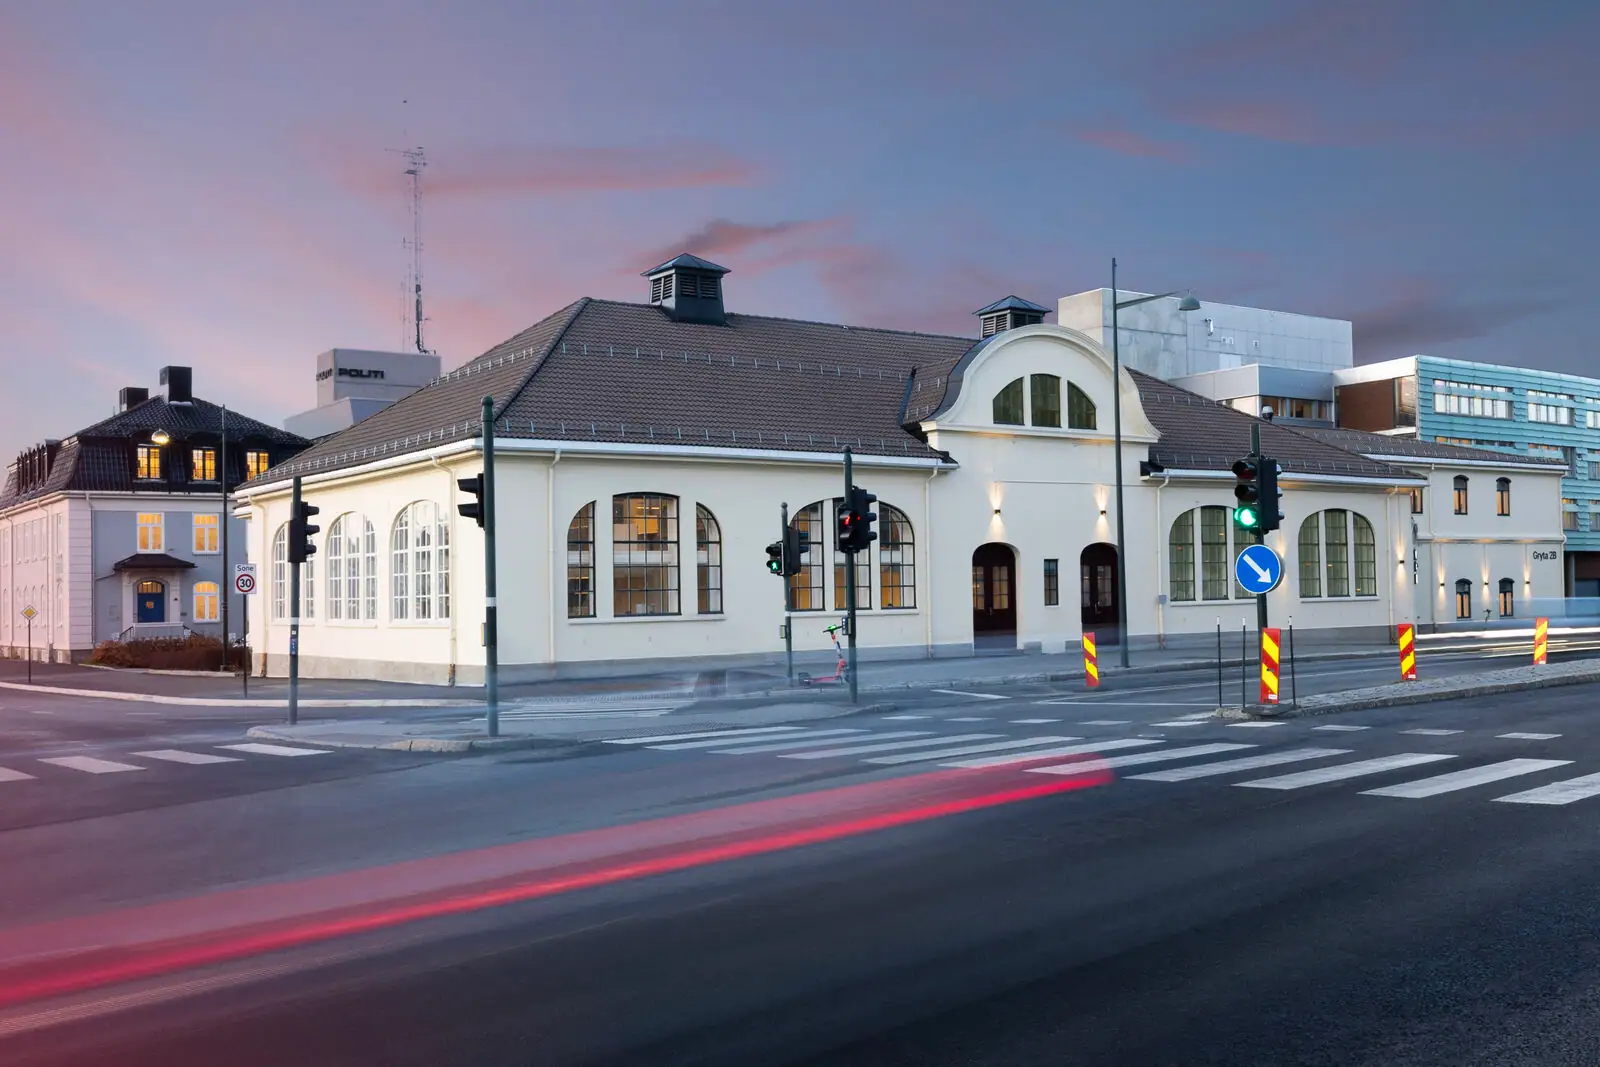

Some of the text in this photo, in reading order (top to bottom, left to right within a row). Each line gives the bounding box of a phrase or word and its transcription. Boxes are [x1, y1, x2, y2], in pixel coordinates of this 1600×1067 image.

[338, 367, 385, 380] POLITI
[236, 564, 254, 572] Sone
[240, 578, 252, 588] 30
